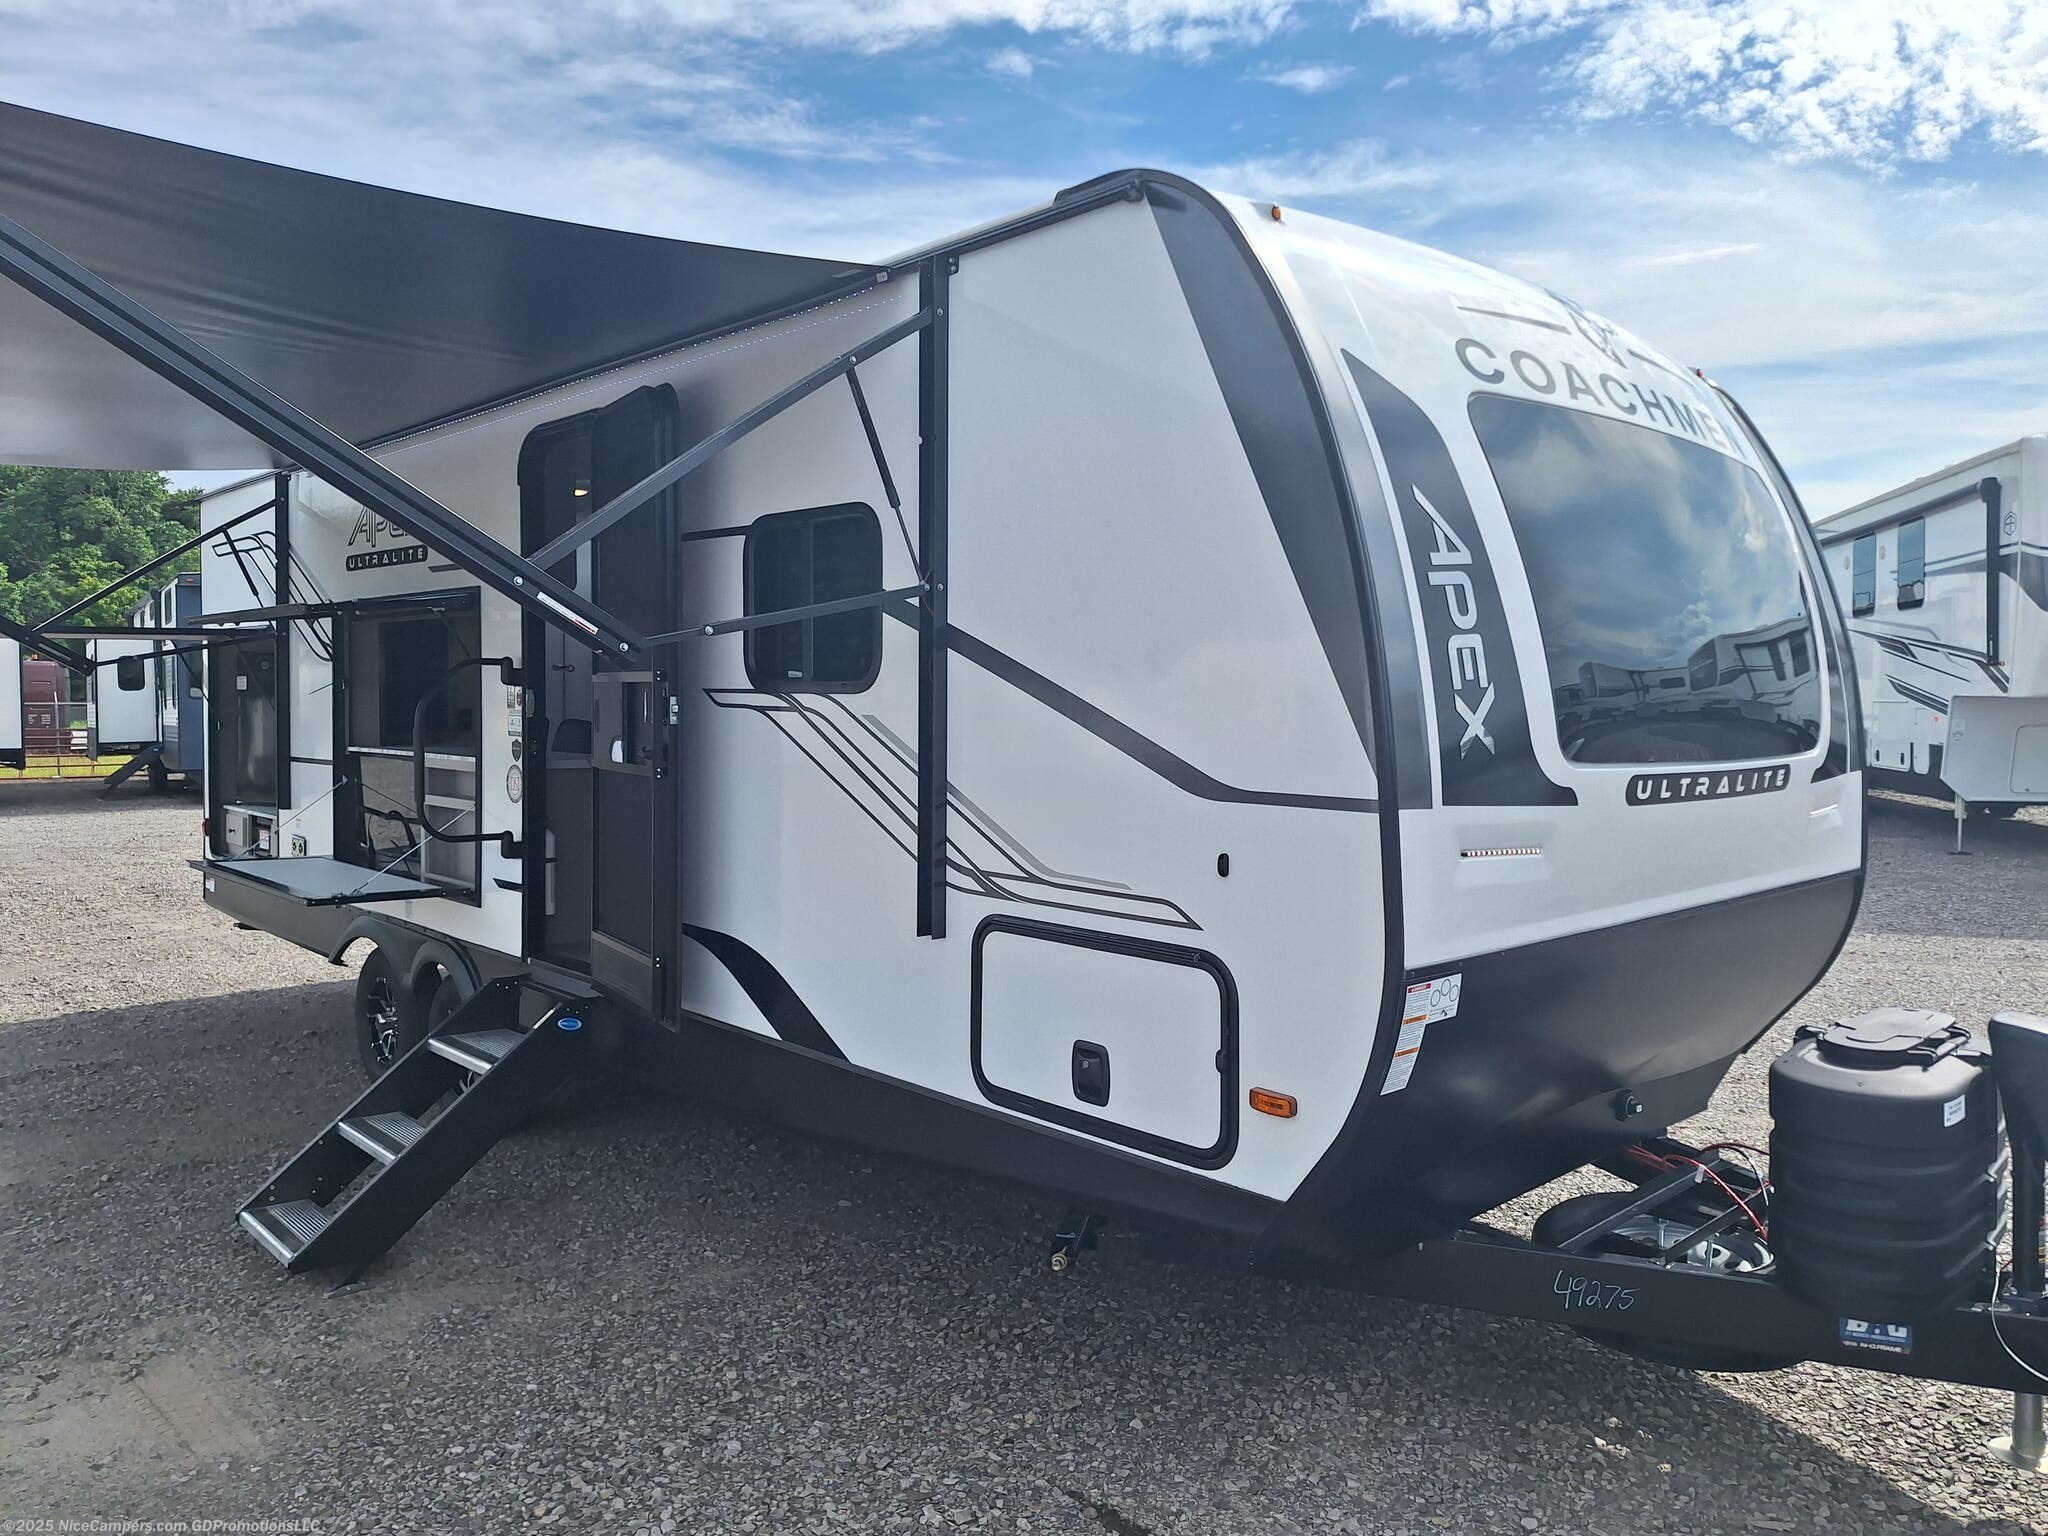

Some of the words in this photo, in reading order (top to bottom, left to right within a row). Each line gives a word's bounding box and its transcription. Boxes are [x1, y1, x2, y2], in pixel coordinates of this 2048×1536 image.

[348, 505, 409, 548] AP
[349, 547, 424, 568] ULTRALITE
[1411, 484, 1495, 760] APEX
[1636, 768, 1786, 800] ULTRALITE
[1554, 1270, 1640, 1309] 49275
